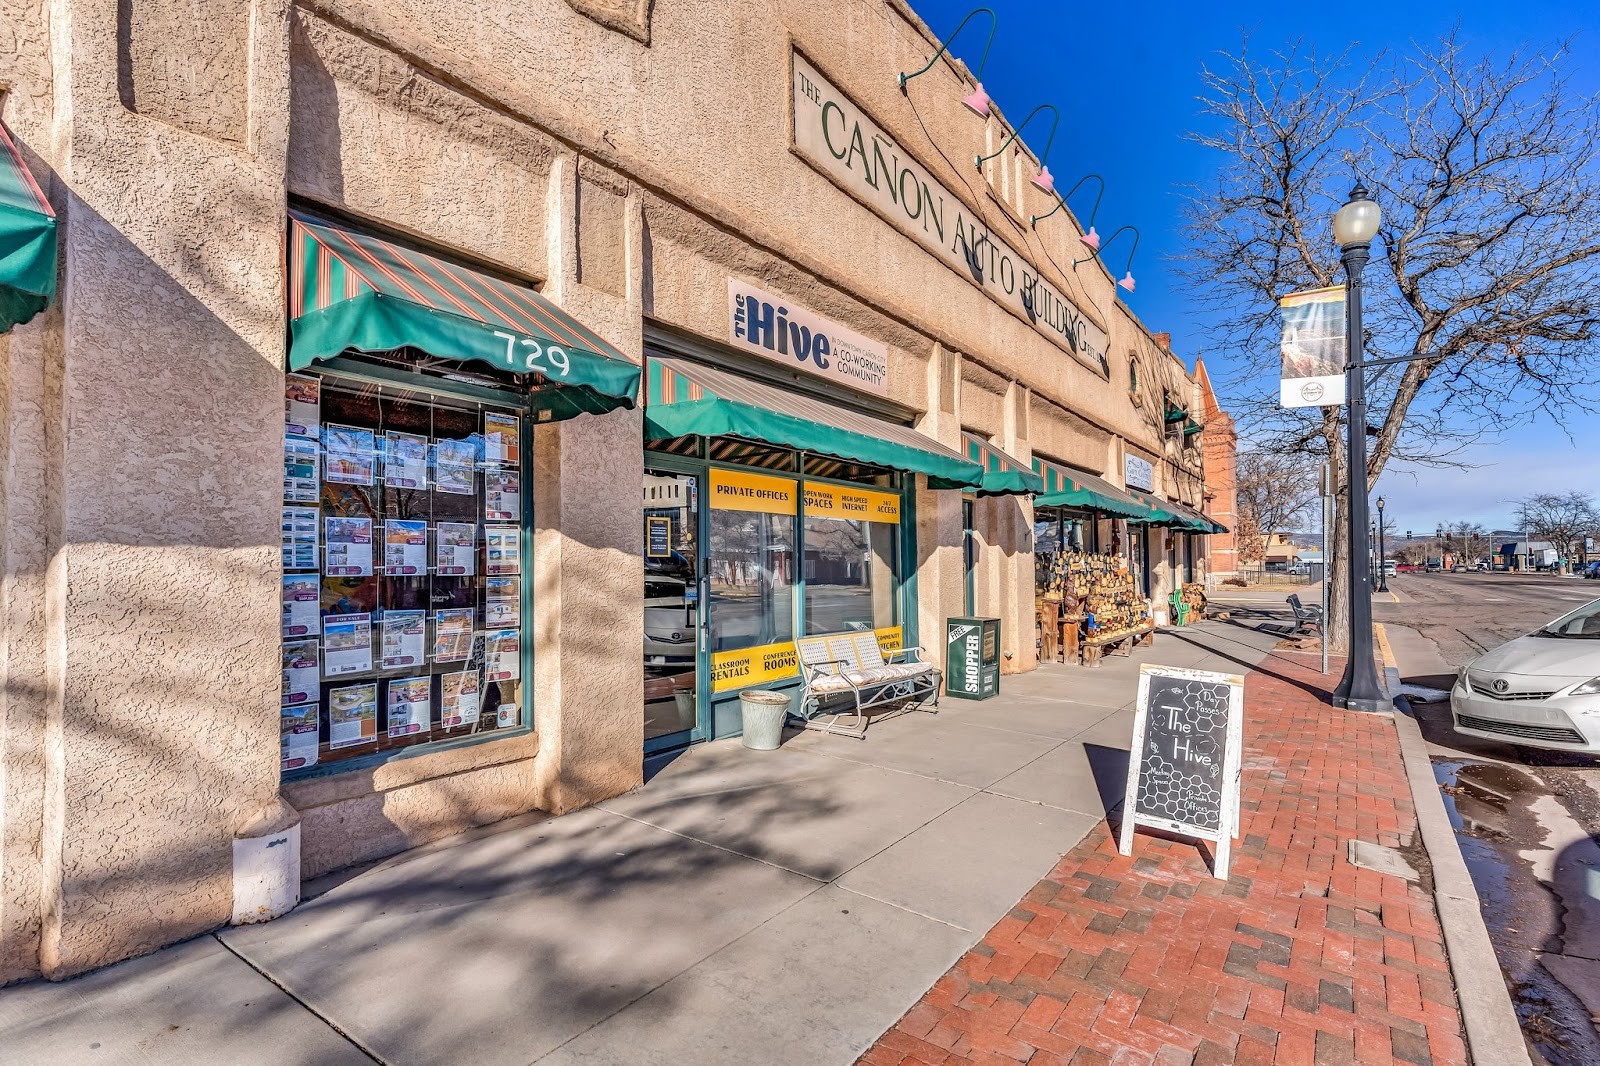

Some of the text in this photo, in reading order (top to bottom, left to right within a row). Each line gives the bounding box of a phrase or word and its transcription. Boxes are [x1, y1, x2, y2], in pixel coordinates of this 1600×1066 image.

[799, 72, 821, 107] THE
[822, 101, 943, 243] CAÑON
[952, 212, 1014, 294] AUTO
[1022, 270, 1086, 351] BUILDING
[734, 294, 745, 338] The
[746, 296, 830, 369] Hive
[494, 331, 570, 376] 729
[837, 339, 862, 354] DOWNTOWN
[833, 347, 886, 376] A CO-WORKING
[838, 361, 882, 386] COMMUNITY
[717, 484, 789, 501] PRIVATE OFFICES
[841, 495, 868, 504] HIGH SPEED
[803, 497, 833, 509] SPACES
[842, 503, 868, 512] INTERNET
[877, 506, 897, 514] ACCESS
[950, 625, 966, 640] FREE
[763, 650, 797, 661] CONFERENCE
[711, 658, 750, 671] CLASSROOM
[764, 657, 796, 671] ROOMS
[965, 635, 979, 693] SHOPPER
[711, 666, 750, 682] RENTALS
[1195, 700, 1220, 715] Passes
[1203, 691, 1220, 708] Day
[1161, 705, 1191, 733] The
[1173, 737, 1212, 766] Hive
